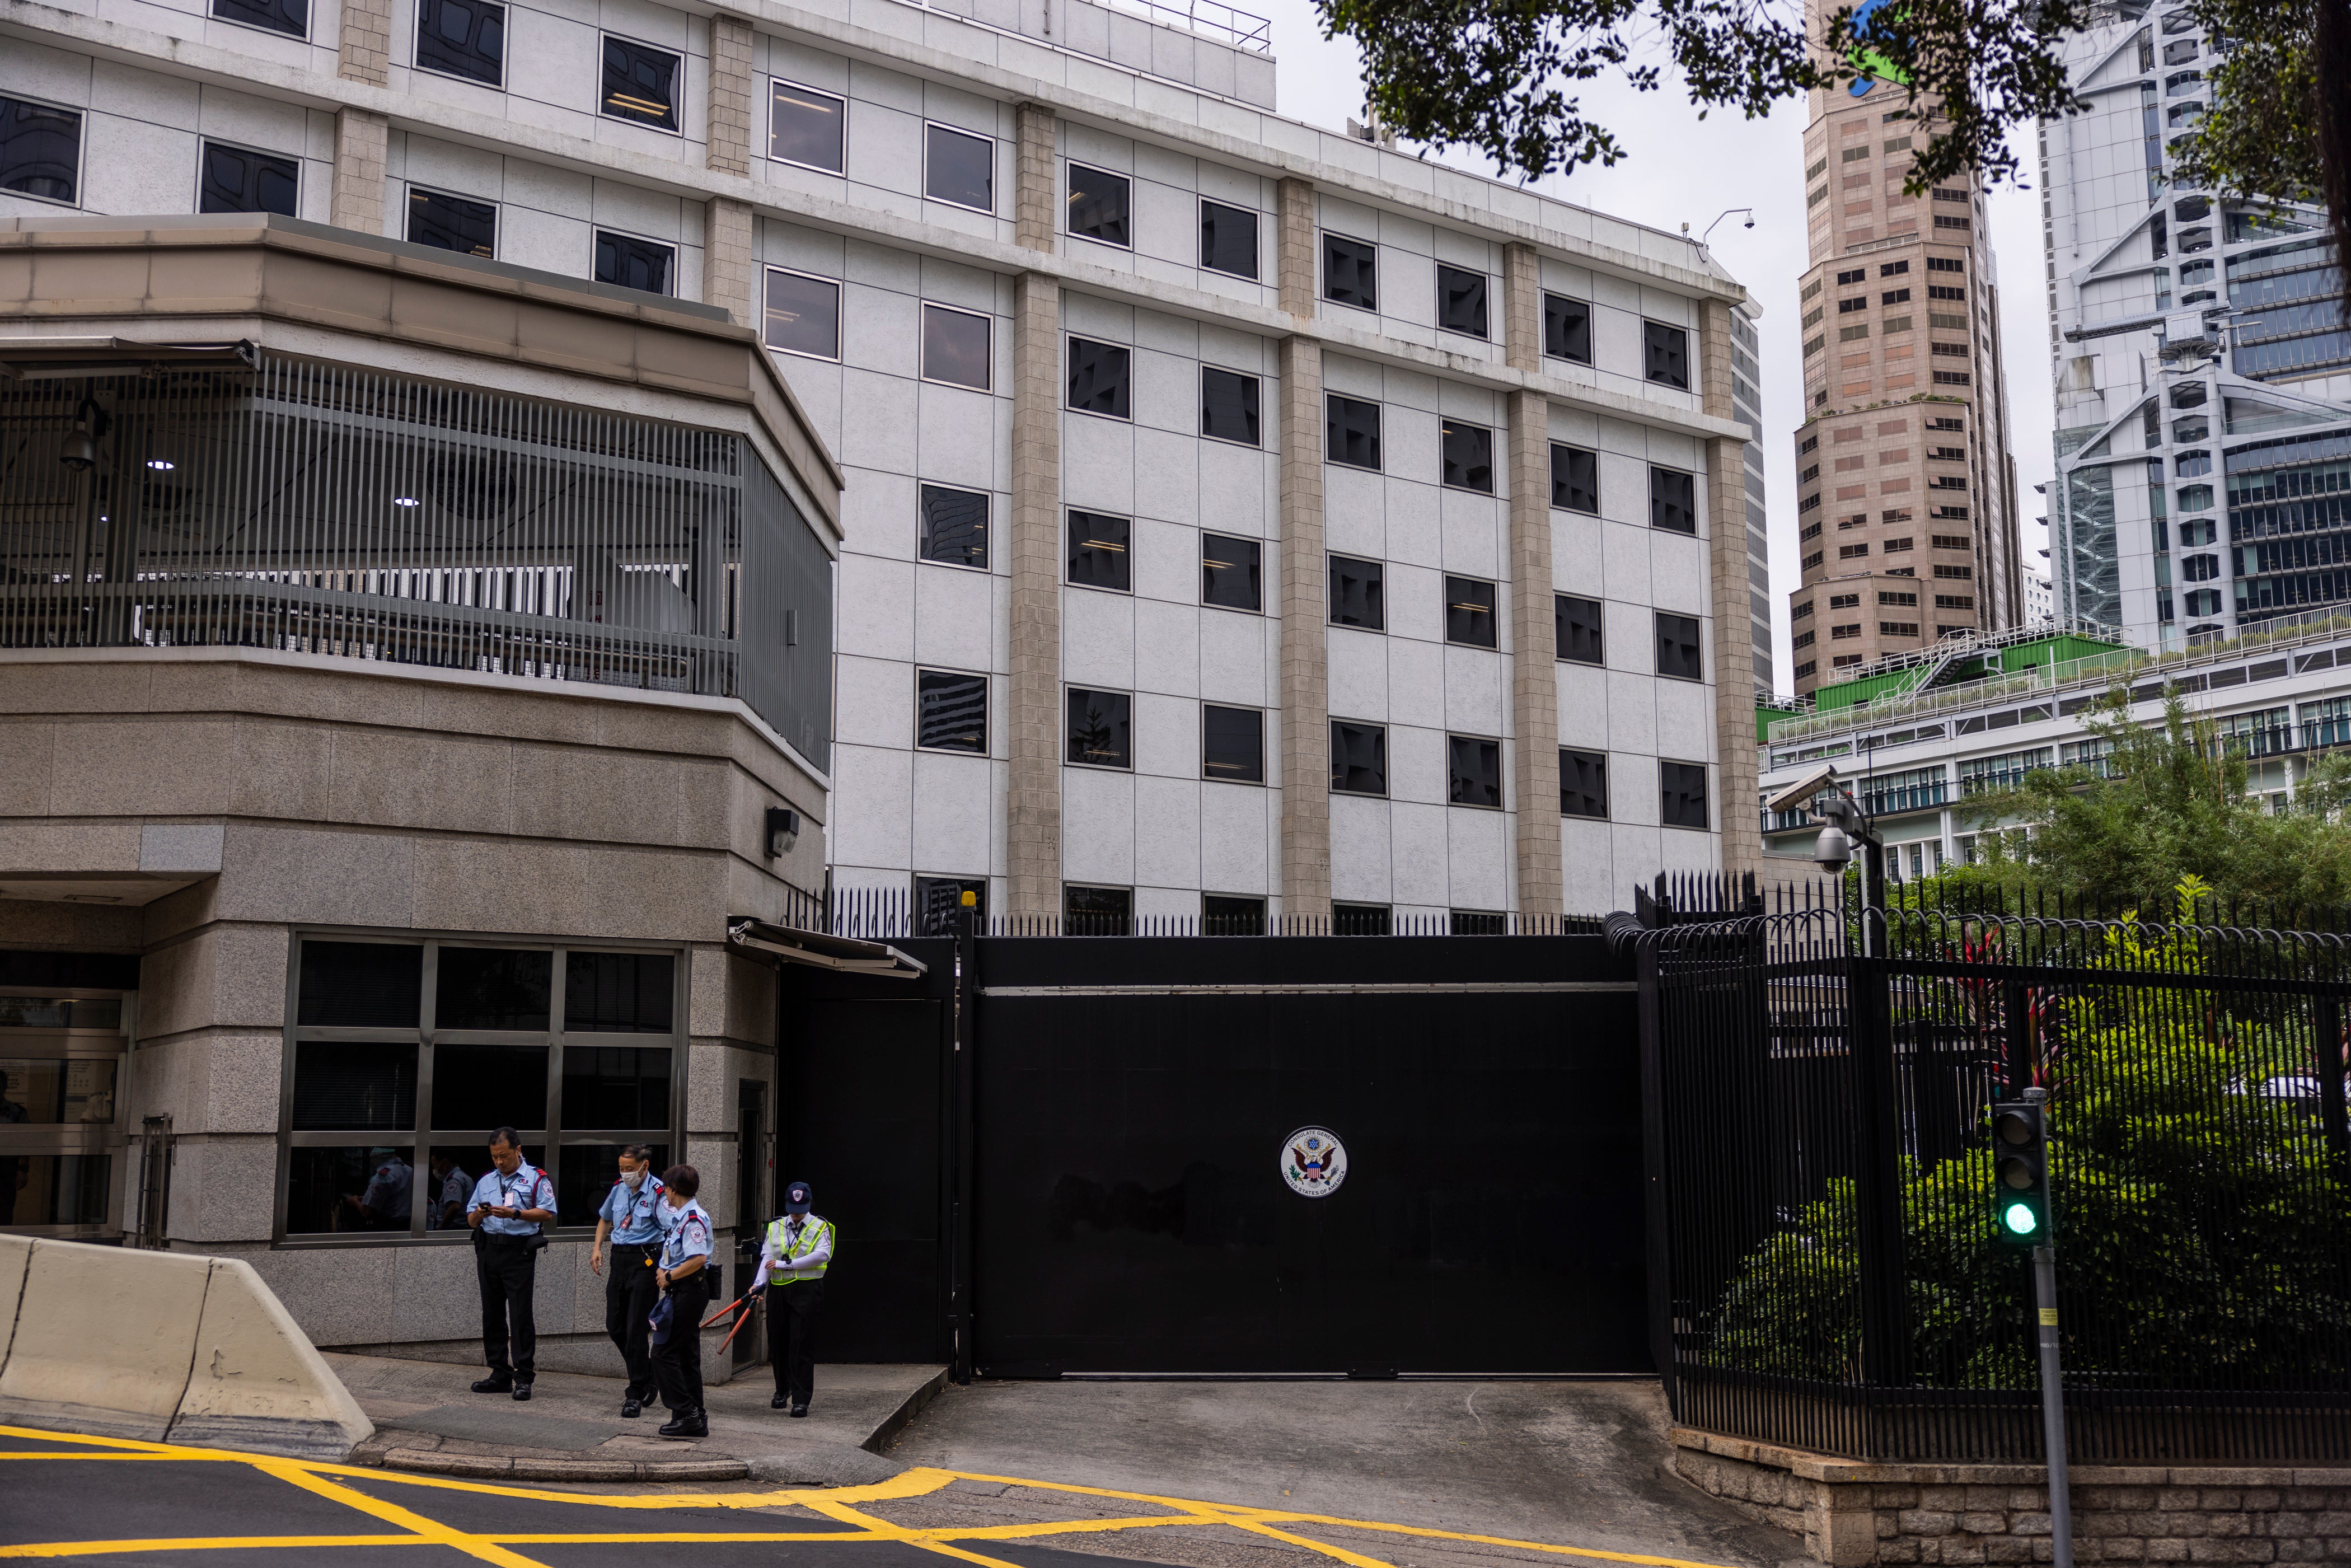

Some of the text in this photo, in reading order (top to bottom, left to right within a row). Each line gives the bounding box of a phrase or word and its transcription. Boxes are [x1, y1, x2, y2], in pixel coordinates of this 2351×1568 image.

[1287, 1130, 1338, 1147] CONSULATE GENERAL
[1284, 1172, 1298, 1188] UNITED
[1328, 1171, 1345, 1191] AMERICA
[1834, 1540, 1873, 1556] 6622
